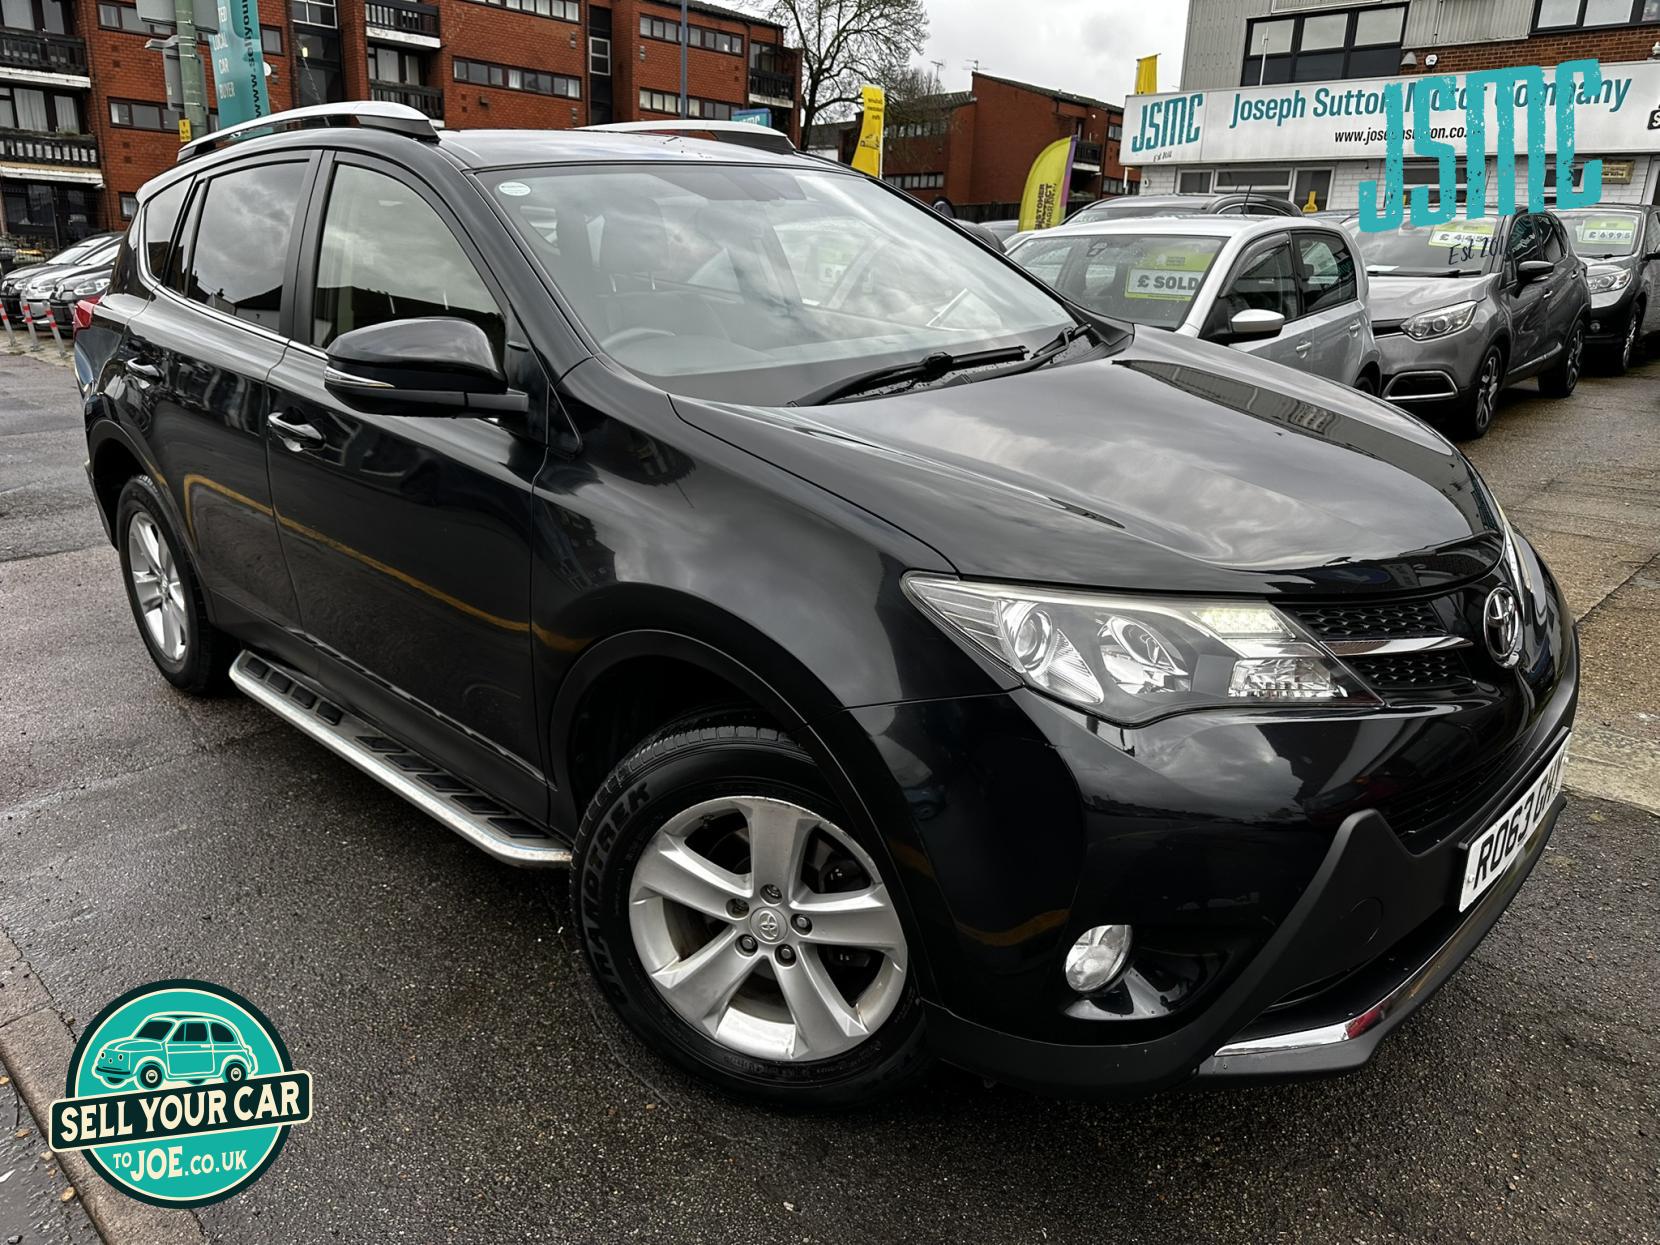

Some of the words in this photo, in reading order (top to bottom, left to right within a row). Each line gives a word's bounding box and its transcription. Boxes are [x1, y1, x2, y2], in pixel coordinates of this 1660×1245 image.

[219, 58, 229, 74] CAR
[1131, 93, 1203, 152] JSMC
[1229, 89, 1306, 129] Joseph
[1137, 274, 1149, 288] £
[1153, 275, 1199, 290] SOLD
